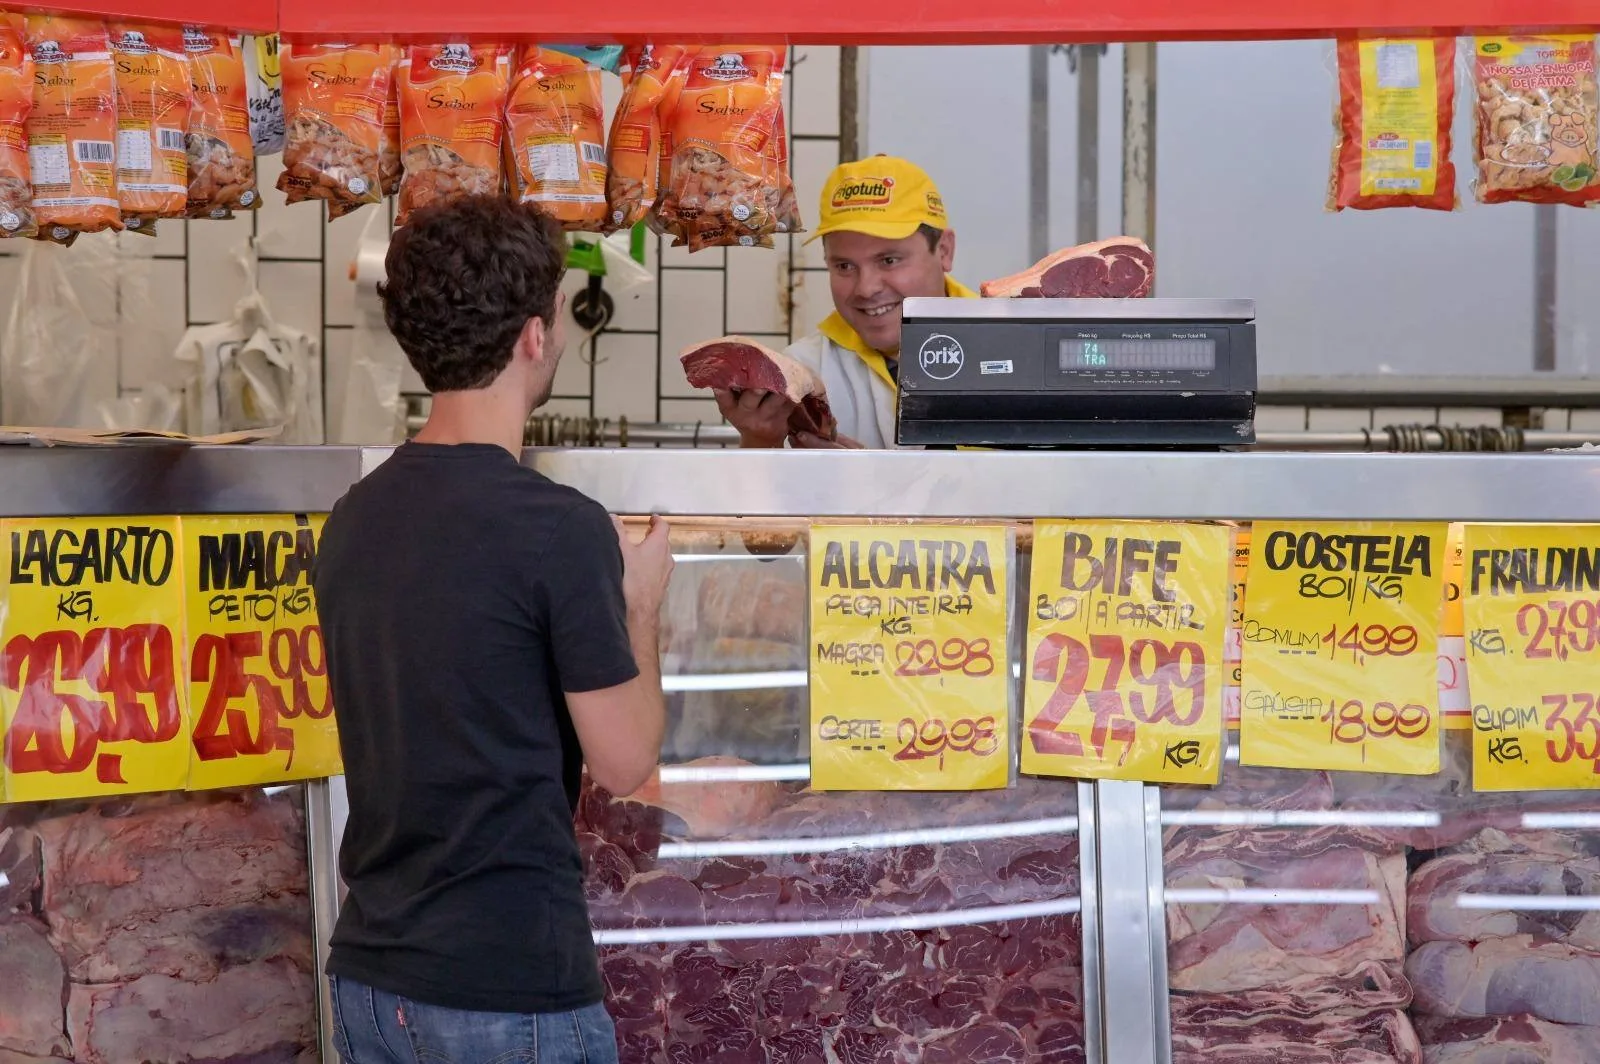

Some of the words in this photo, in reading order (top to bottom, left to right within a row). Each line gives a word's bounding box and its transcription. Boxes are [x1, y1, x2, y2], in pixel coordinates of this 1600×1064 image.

[34, 71, 76, 86] Sabor
[116, 60, 161, 75] Sabor
[308, 70, 359, 85] Sabor
[1489, 65, 1532, 75] NOSSA
[1535, 62, 1593, 74] SENHORA
[537, 79, 576, 92] Sabor
[1512, 78, 1528, 88] DE
[1530, 74, 1576, 88] FÁTIMA
[427, 94, 478, 109] Sabor
[697, 101, 749, 116] Sabor
[679, 210, 697, 219] 00g
[924, 347, 960, 367] prix
[1084, 343, 1098, 353] 74
[10, 526, 173, 586] LAGARTO
[1264, 531, 1431, 577] COSTELA
[820, 540, 996, 594] ALCATRA
[1060, 531, 1182, 602] BIFE
[57, 591, 99, 621] KG.
[889, 595, 973, 616] INTEIRA
[1117, 601, 1205, 631] PARTIR
[881, 616, 915, 637] KG.
[1243, 619, 1319, 649] COMUM
[1469, 629, 1513, 656] KG.
[1516, 599, 1600, 662] 27,9
[817, 641, 884, 667] MAGRA
[1028, 632, 1205, 767] 27,99
[818, 715, 882, 740] CORTE
[1163, 740, 1202, 769] KG.
[1488, 737, 1528, 764] KG.
